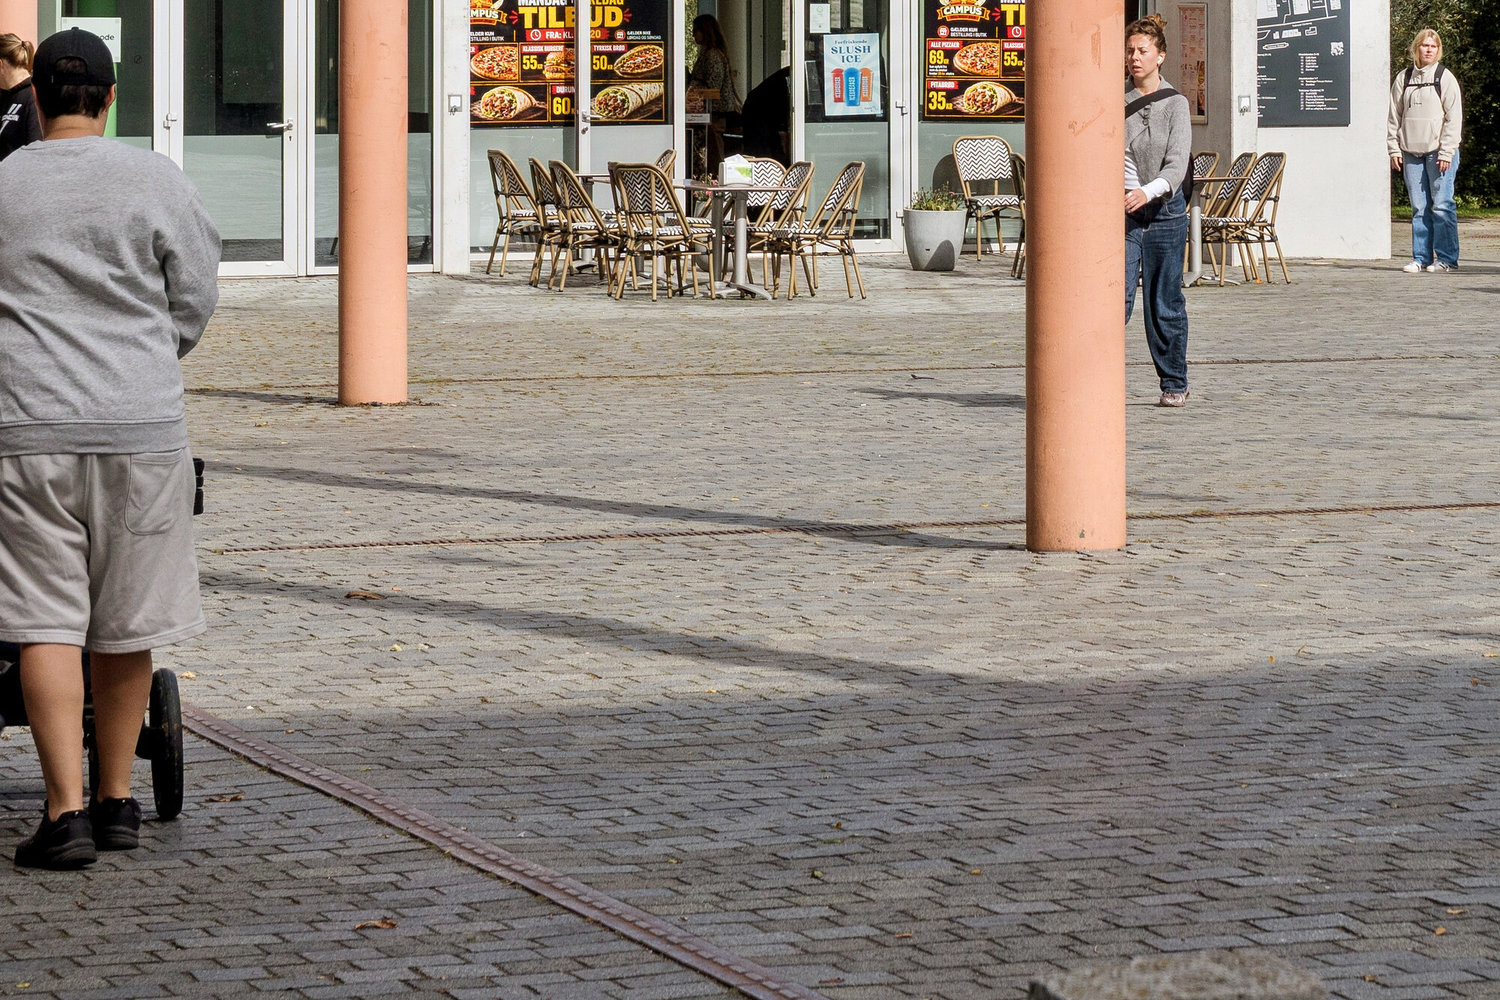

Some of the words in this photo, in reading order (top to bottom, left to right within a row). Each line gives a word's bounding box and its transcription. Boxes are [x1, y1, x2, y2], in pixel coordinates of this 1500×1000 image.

[470, 9, 499, 19] MPUS
[943, 5, 983, 15] CAMPUS
[1001, 3, 1025, 26] TI
[545, 31, 561, 39] FRA:
[831, 45, 871, 54] SLUSH
[841, 55, 861, 63] ICE
